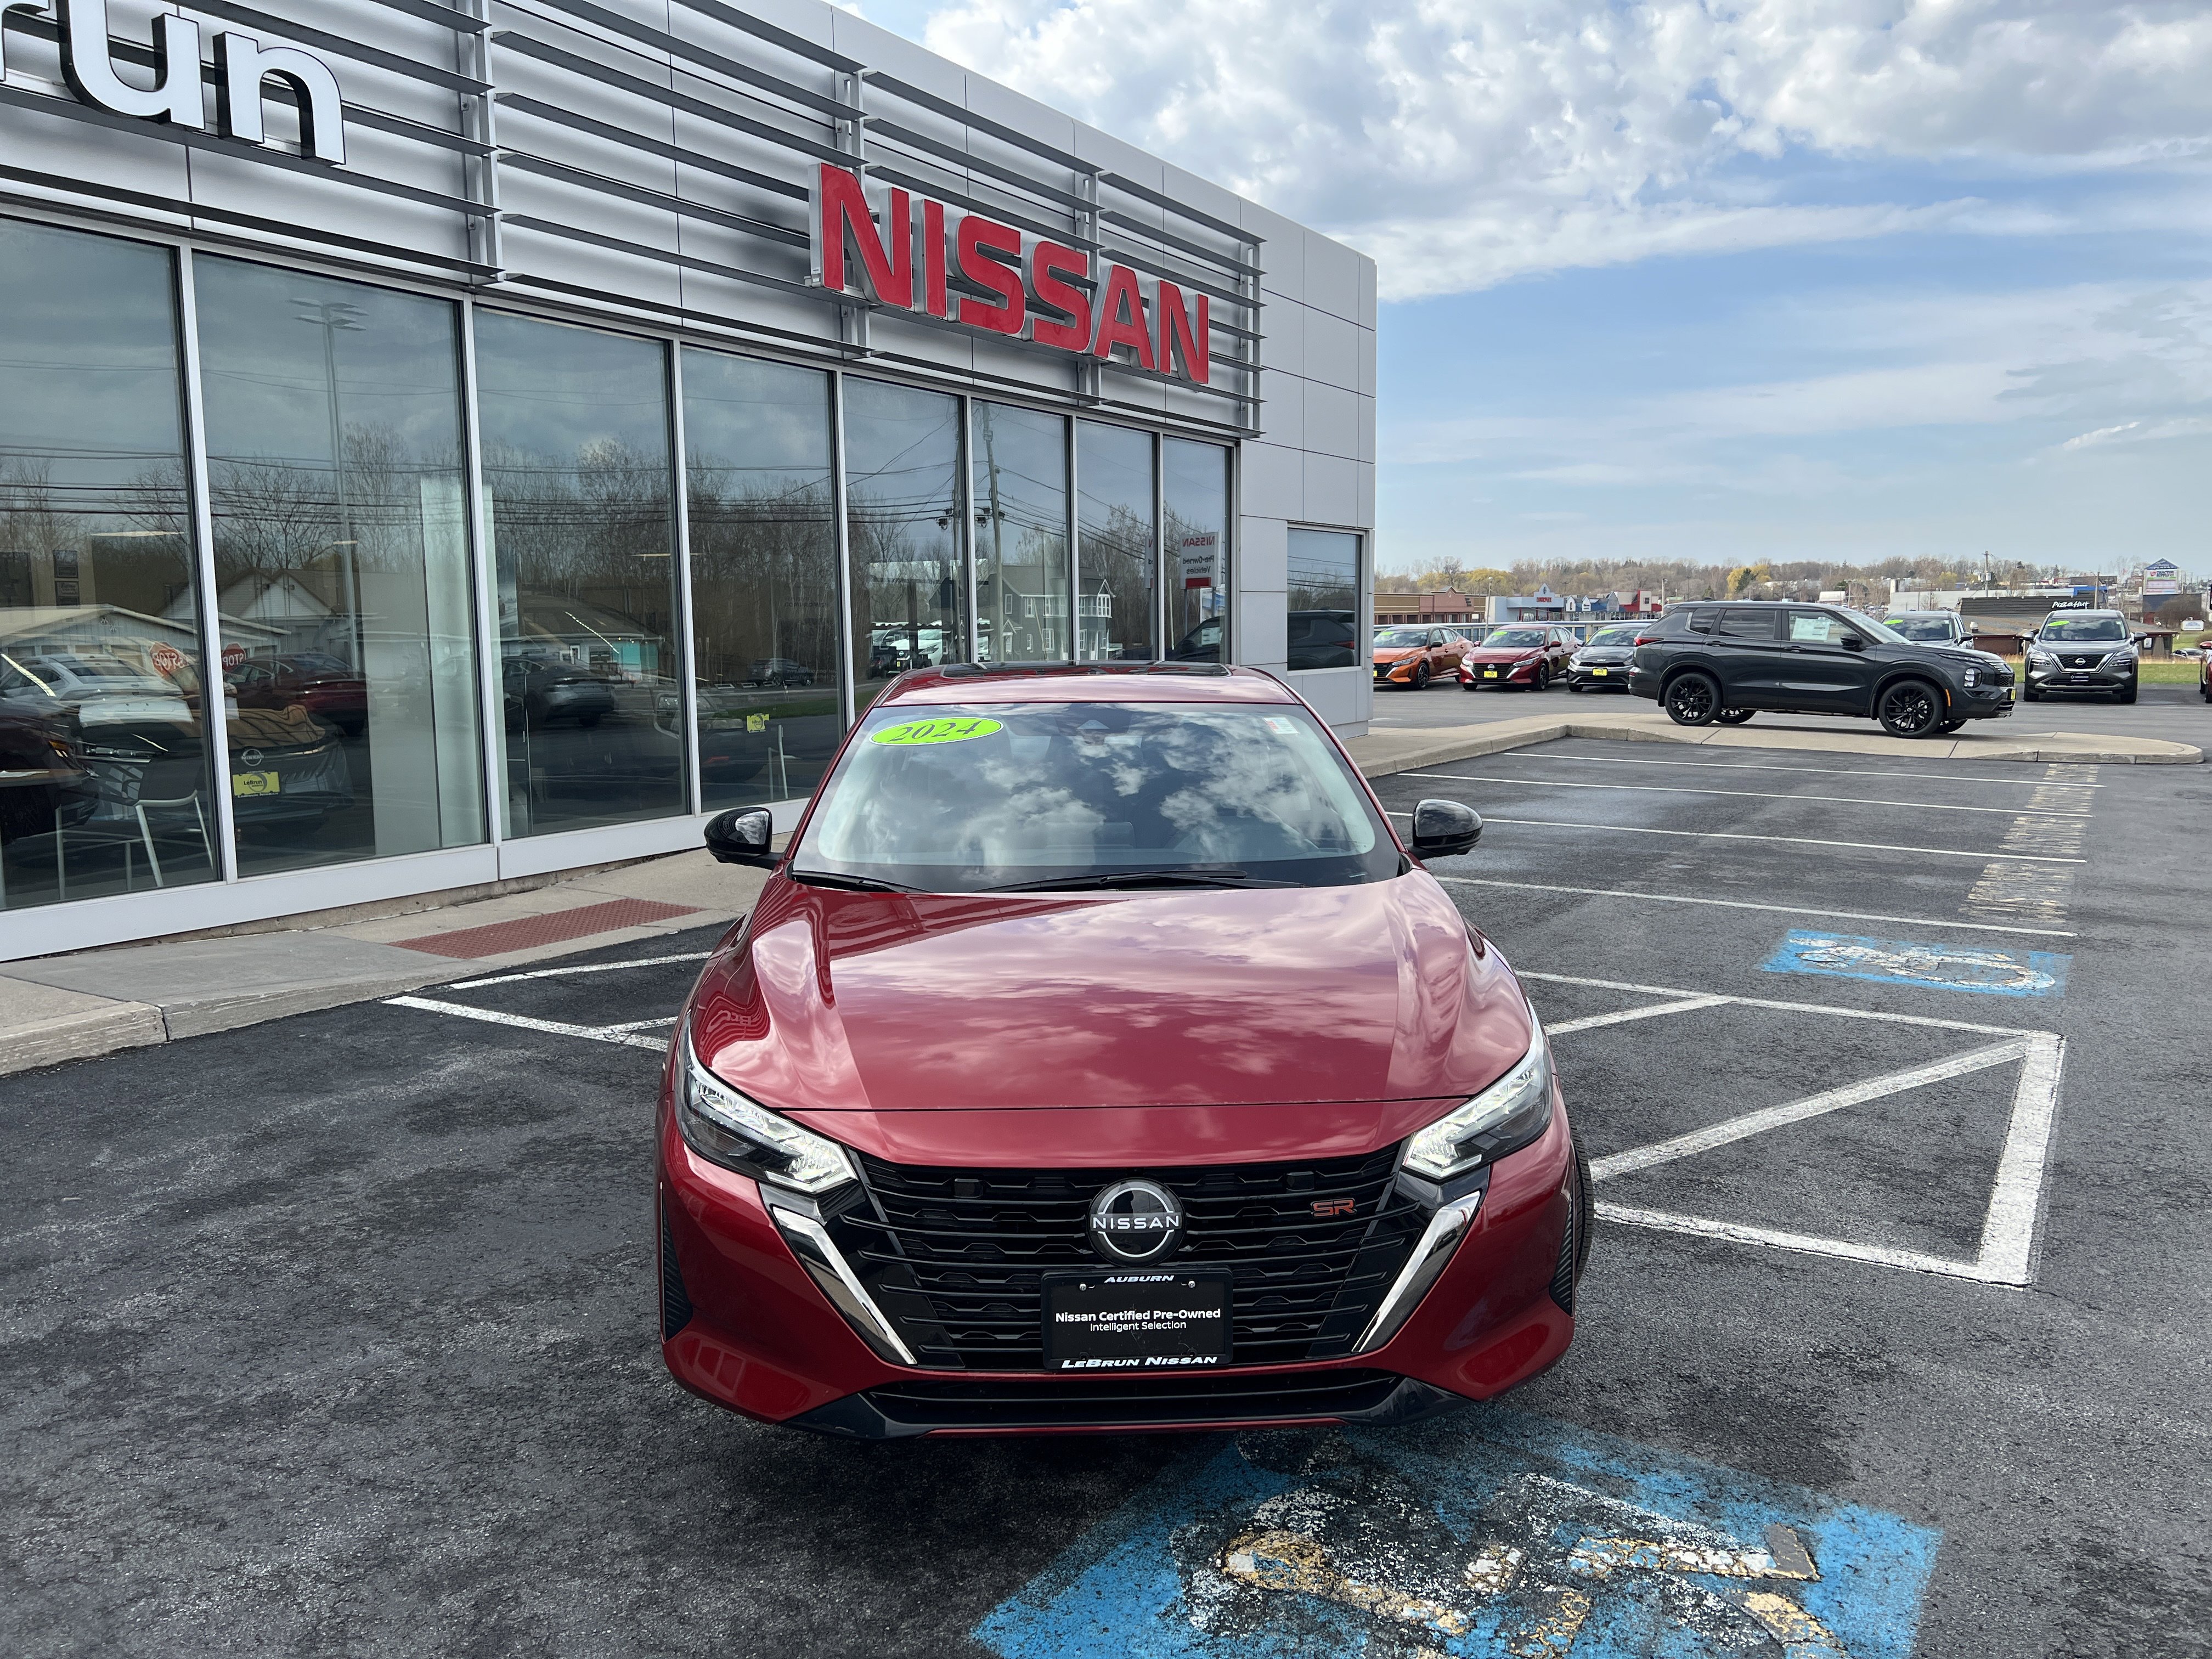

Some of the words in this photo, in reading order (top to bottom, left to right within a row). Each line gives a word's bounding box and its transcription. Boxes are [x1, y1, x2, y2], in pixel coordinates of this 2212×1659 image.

[811, 162, 1209, 384] NISSAN
[887, 720, 983, 742] 2024
[1312, 1199, 1357, 1217] SR
[1092, 1214, 1180, 1231] NISSAN
[1104, 1275, 1175, 1283] AUBURN
[1056, 1312, 1096, 1322] Nissan
[1099, 1310, 1150, 1321] Certified
[1153, 1308, 1221, 1319] Pre-Owned
[1090, 1322, 1139, 1332] Intelligent
[1141, 1321, 1187, 1330] Selection
[1144, 1356, 1217, 1365] NISSAN
